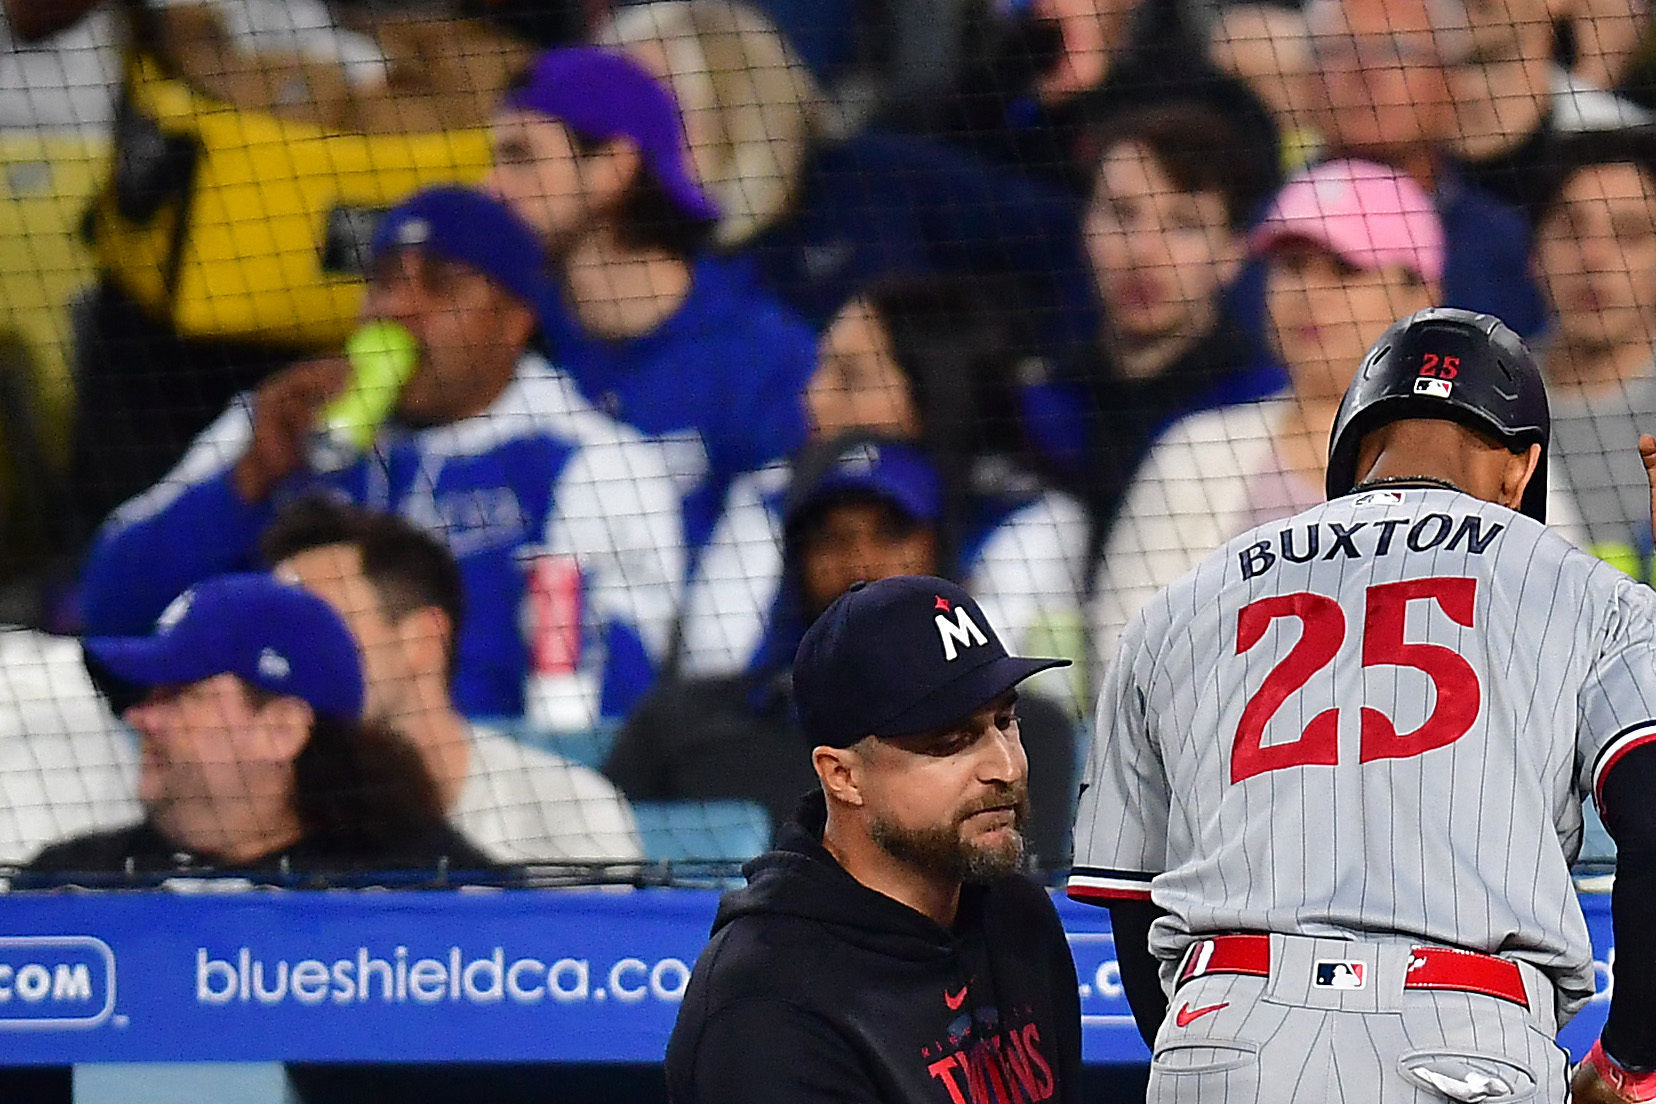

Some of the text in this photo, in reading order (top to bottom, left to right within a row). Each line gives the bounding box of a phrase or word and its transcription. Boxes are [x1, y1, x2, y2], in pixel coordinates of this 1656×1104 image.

[1419, 352, 1460, 379] 25
[1238, 513, 1504, 581] BUXTON
[934, 606, 989, 661] M
[1230, 576, 1481, 785] 25
